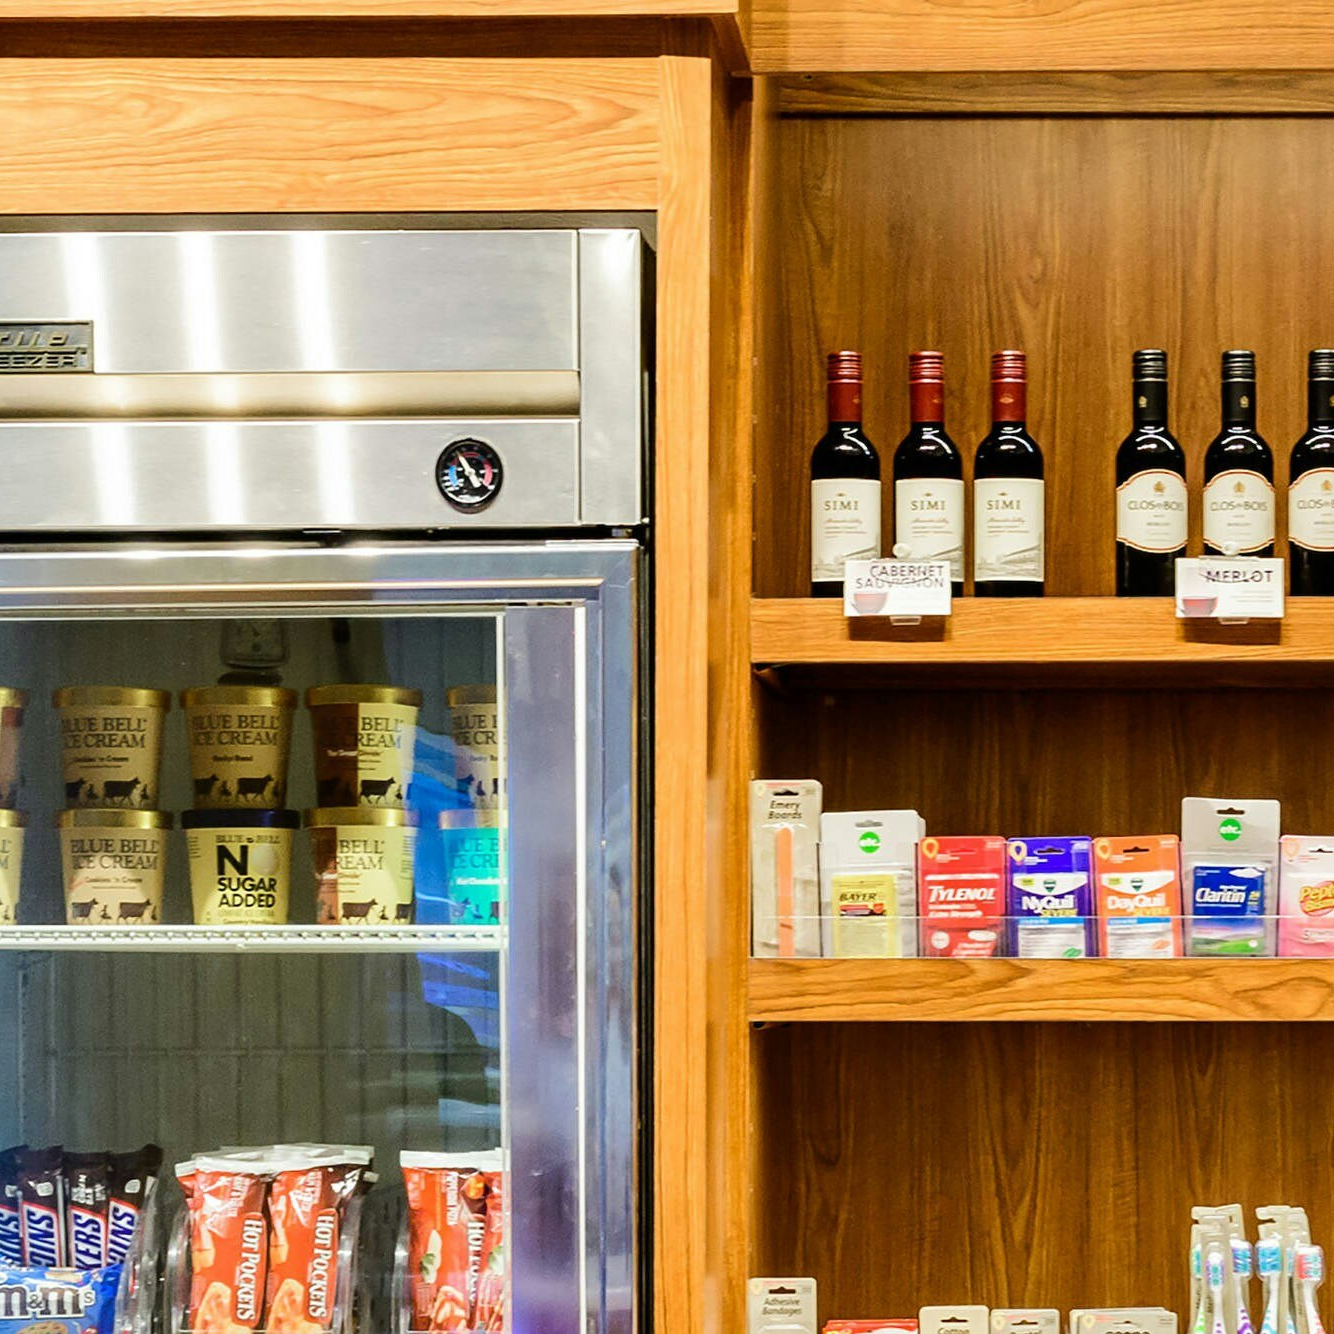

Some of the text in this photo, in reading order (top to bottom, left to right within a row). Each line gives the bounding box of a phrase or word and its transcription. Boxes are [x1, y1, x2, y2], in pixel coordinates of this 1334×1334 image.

[824, 500, 859, 511] SIMI
[910, 500, 946, 511] SIMI
[986, 499, 1021, 510] SIMI
[1128, 501, 1156, 512] CLOS
[1210, 501, 1235, 512] CLOS
[1297, 500, 1323, 511] CLOS
[870, 565, 944, 577] CABERNET
[1206, 570, 1274, 583] MERLOT
[103, 717, 147, 732] BELL
[237, 714, 279, 730] BELL
[84, 733, 145, 749] CREAM
[218, 730, 278, 747] CREAM
[770, 800, 800, 810] Emery
[768, 811, 803, 820] Boards
[70, 838, 159, 854] BLUE BELL
[339, 839, 384, 855] BELL
[72, 854, 158, 870] ICE CREAM
[218, 877, 277, 893] SUGAR
[218, 893, 276, 909] ADDED
[839, 892, 878, 902] BAYER
[928, 885, 997, 903] TYLENOL
[1195, 886, 1245, 904] Claritin
[1021, 894, 1076, 915] NyQuil
[1107, 894, 1166, 913] DayQuil
[236, 1218, 262, 1321] HOT POCKETS
[308, 1215, 334, 1319] HOT POCKETS
